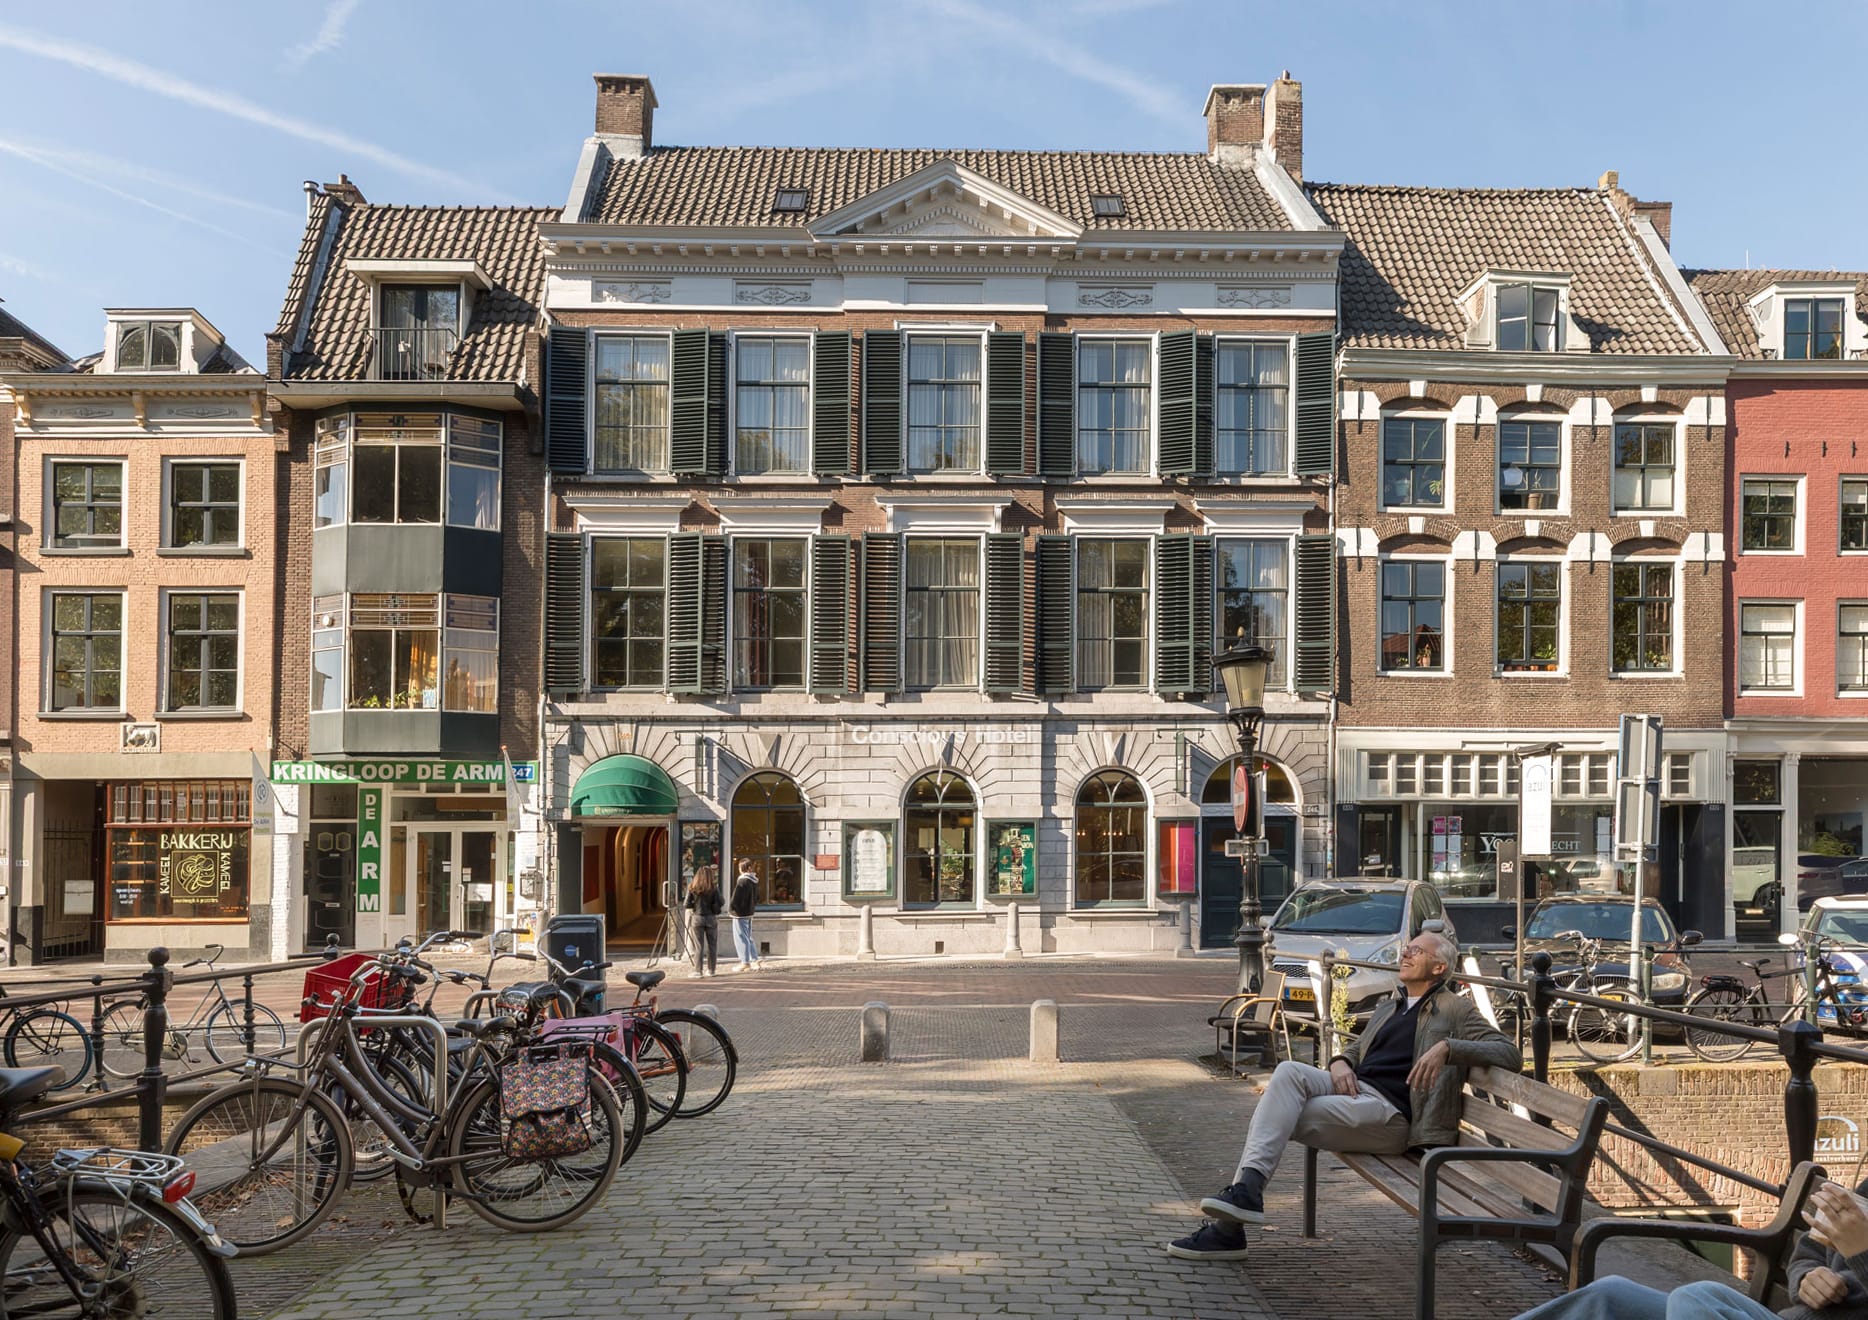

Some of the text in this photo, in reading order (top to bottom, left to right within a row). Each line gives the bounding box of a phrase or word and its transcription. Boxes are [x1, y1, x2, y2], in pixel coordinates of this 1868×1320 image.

[852, 724, 1031, 744] Conscious Hotel
[273, 764, 503, 780] KRINGLOOP DE ARM
[160, 833, 233, 850] BAKKERIJ
[1552, 840, 1581, 850] ECHT
[160, 854, 171, 894] KAMEEL
[220, 852, 231, 893] KAMEEL
